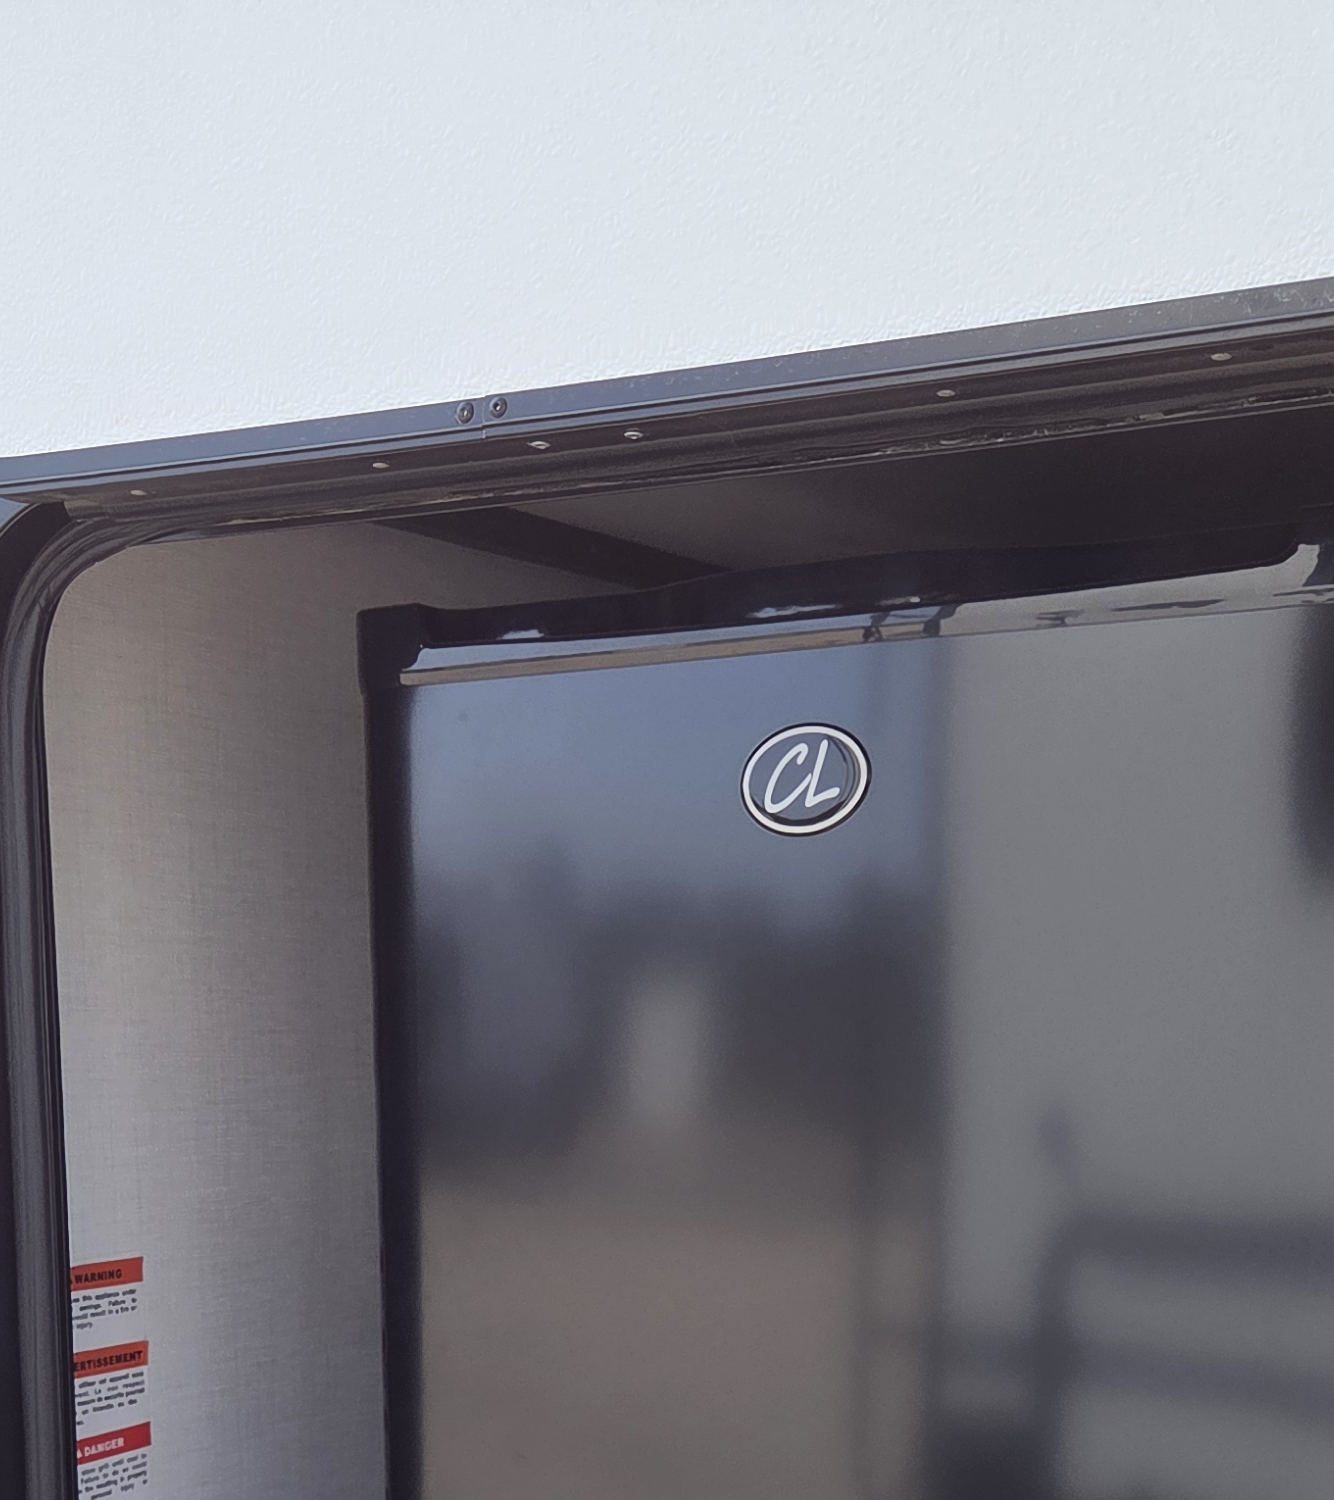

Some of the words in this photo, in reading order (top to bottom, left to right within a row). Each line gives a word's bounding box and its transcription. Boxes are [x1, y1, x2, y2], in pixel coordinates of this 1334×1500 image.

[764, 739, 840, 813] CL
[74, 1268, 123, 1284] WARNING
[74, 1350, 143, 1372] ERTISSEMENT
[84, 1437, 125, 1457] DANGER
